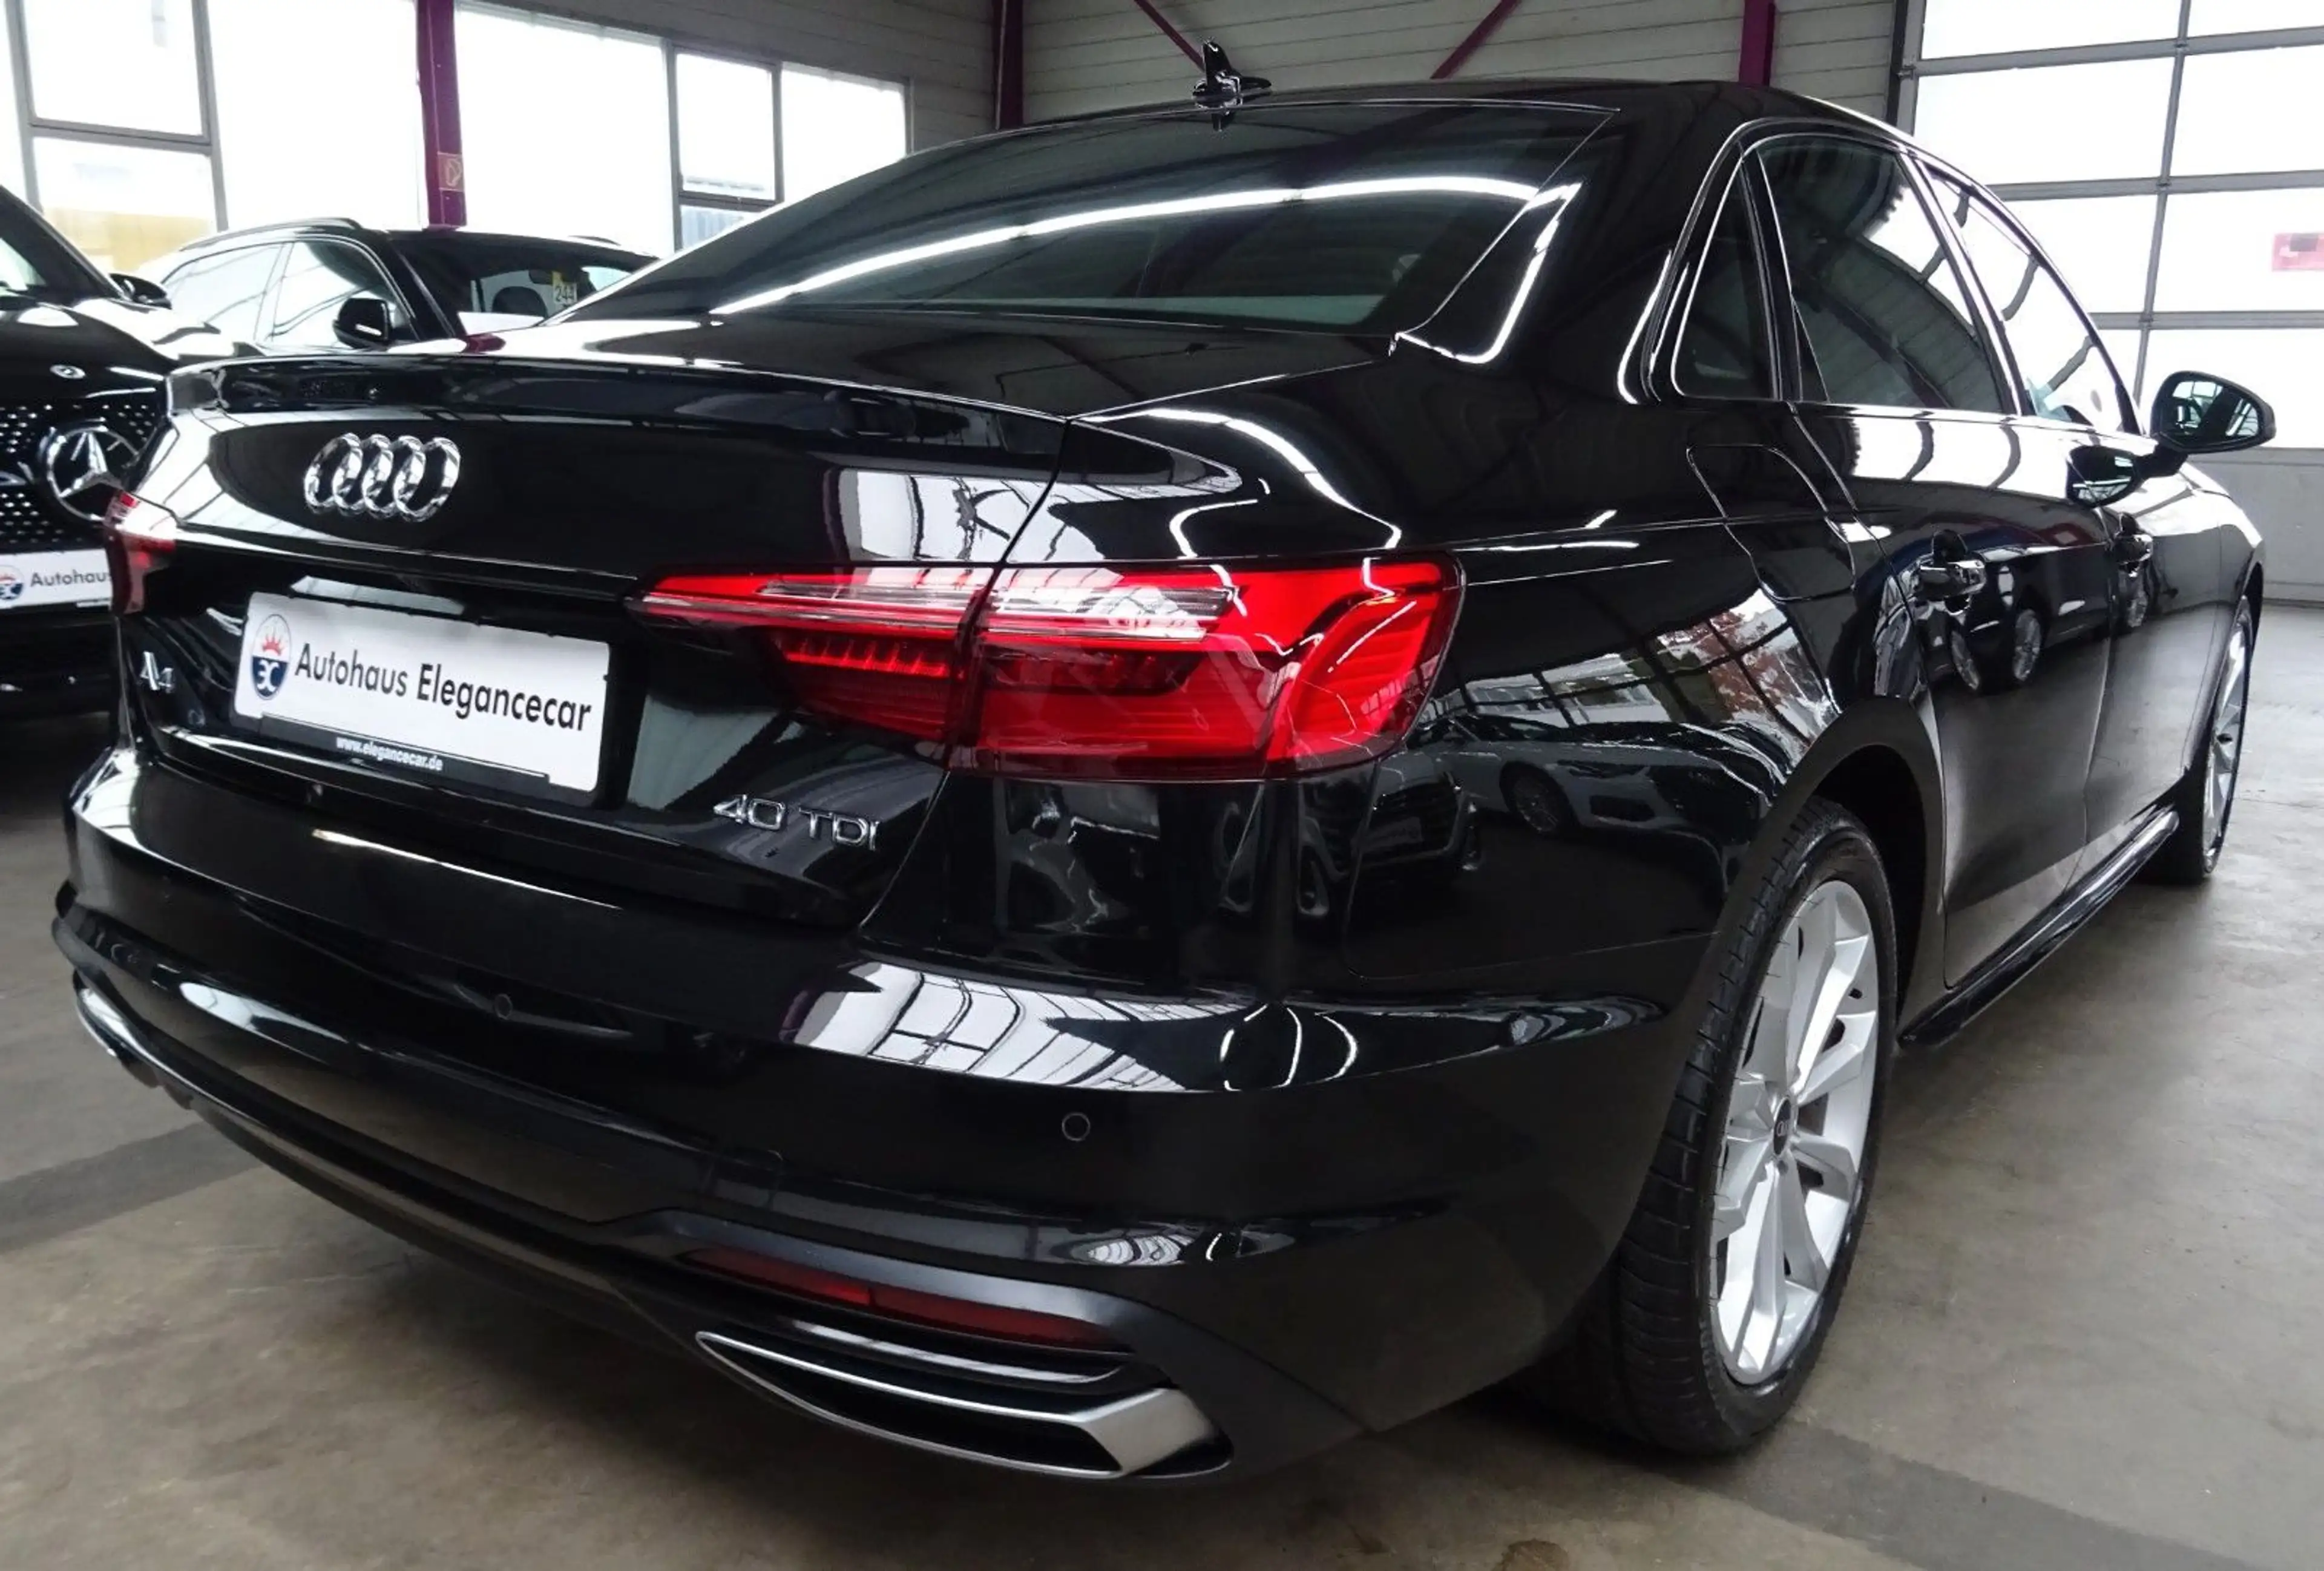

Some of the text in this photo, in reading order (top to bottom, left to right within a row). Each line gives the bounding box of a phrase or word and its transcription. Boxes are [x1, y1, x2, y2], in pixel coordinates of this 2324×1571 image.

[140, 651, 174, 694] A4
[294, 643, 592, 731] Autohaus Elegancecar
[336, 736, 444, 771] www.elegancecar.de
[713, 794, 879, 851] 40 TDI
